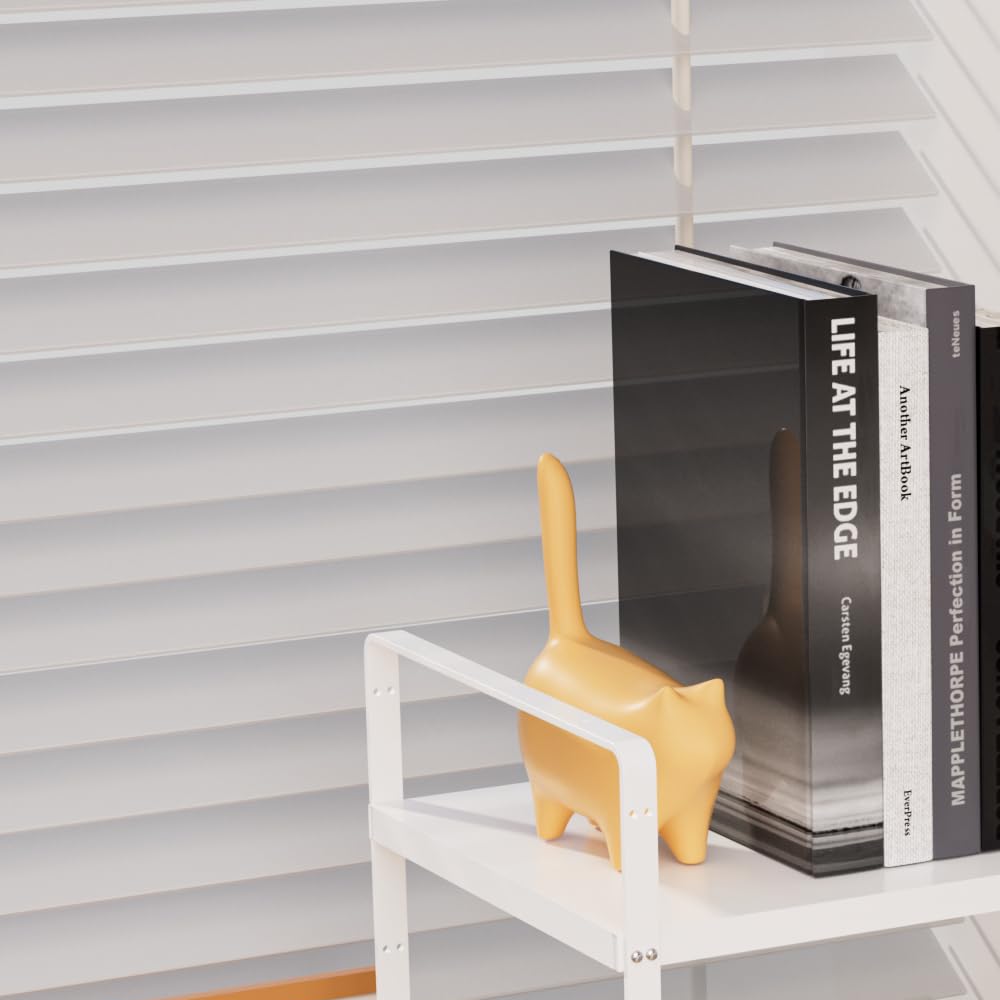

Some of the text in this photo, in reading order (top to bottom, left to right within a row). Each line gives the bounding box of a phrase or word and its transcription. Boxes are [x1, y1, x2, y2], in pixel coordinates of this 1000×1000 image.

[831, 317, 858, 560] LIFE AT THE EDGE
[900, 385, 912, 502] Another ArtBook
[838, 597, 852, 696] Carsten Egevang
[948, 473, 966, 806] MAPPLETHORPE Perfection in Form
[904, 790, 912, 836] EverPress
